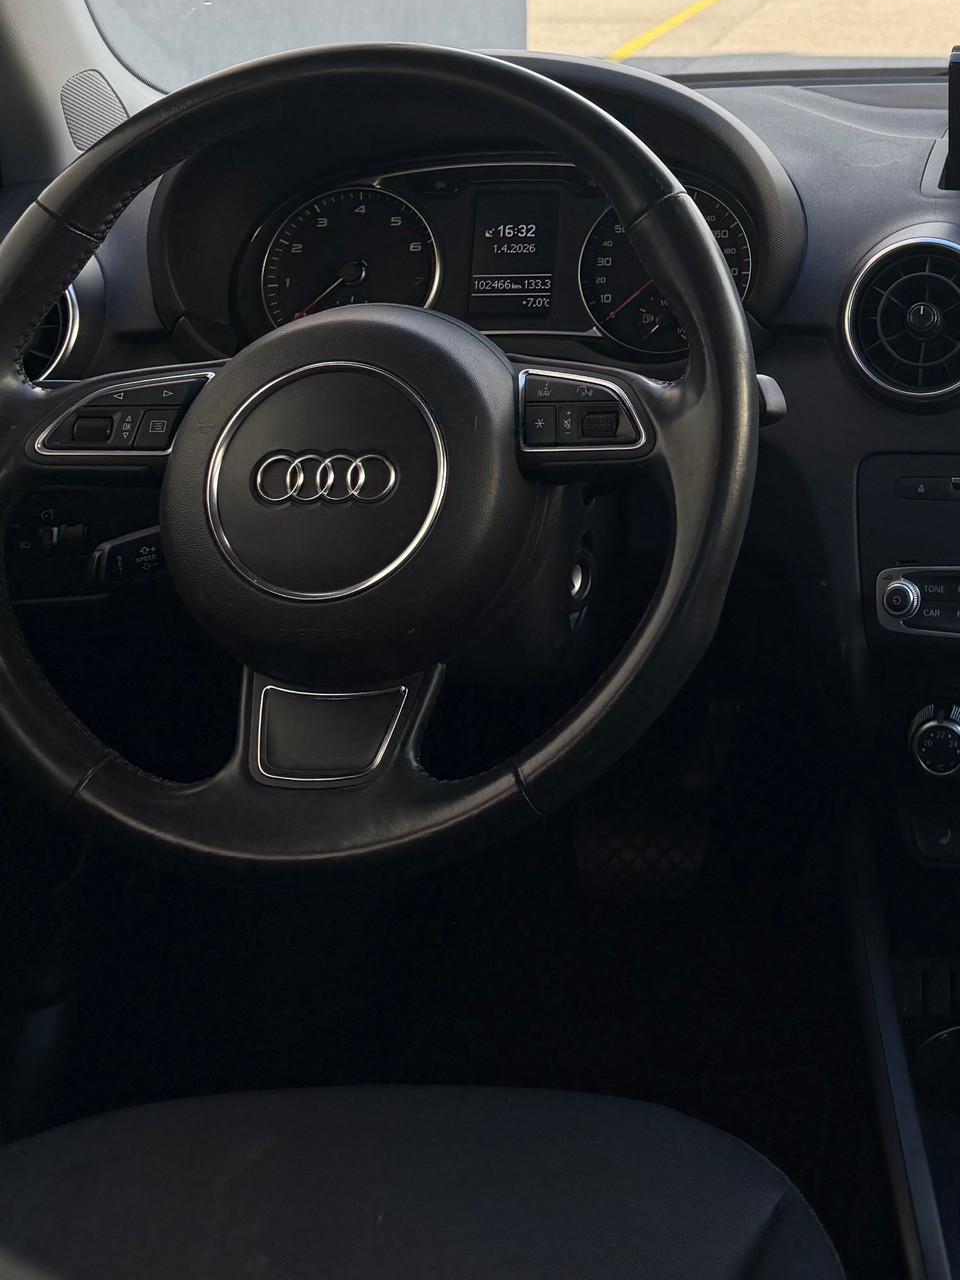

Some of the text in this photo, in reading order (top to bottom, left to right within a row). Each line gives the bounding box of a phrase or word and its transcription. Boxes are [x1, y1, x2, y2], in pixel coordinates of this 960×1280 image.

[353, 204, 367, 215] 4
[315, 217, 328, 228] 3
[389, 216, 402, 227] 5
[497, 224, 537, 238] 16:32
[290, 243, 303, 253] 2
[409, 242, 422, 252] 6
[492, 243, 537, 254] 1.4.2026
[601, 239, 614, 248] 40
[596, 256, 612, 267] 30
[284, 277, 291, 288] 1
[413, 275, 425, 286] 7
[523, 278, 552, 290] 133.3
[595, 276, 607, 285] 20
[600, 294, 612, 304] 10
[536, 389, 553, 397] NAV
[122, 422, 132, 431] OK
[135, 553, 157, 564] SPEED
[923, 584, 946, 594] TONE
[922, 608, 941, 618] CAR
[936, 731, 945, 739] 22
[923, 739, 933, 747] 20
[949, 740, 958, 748] 24
